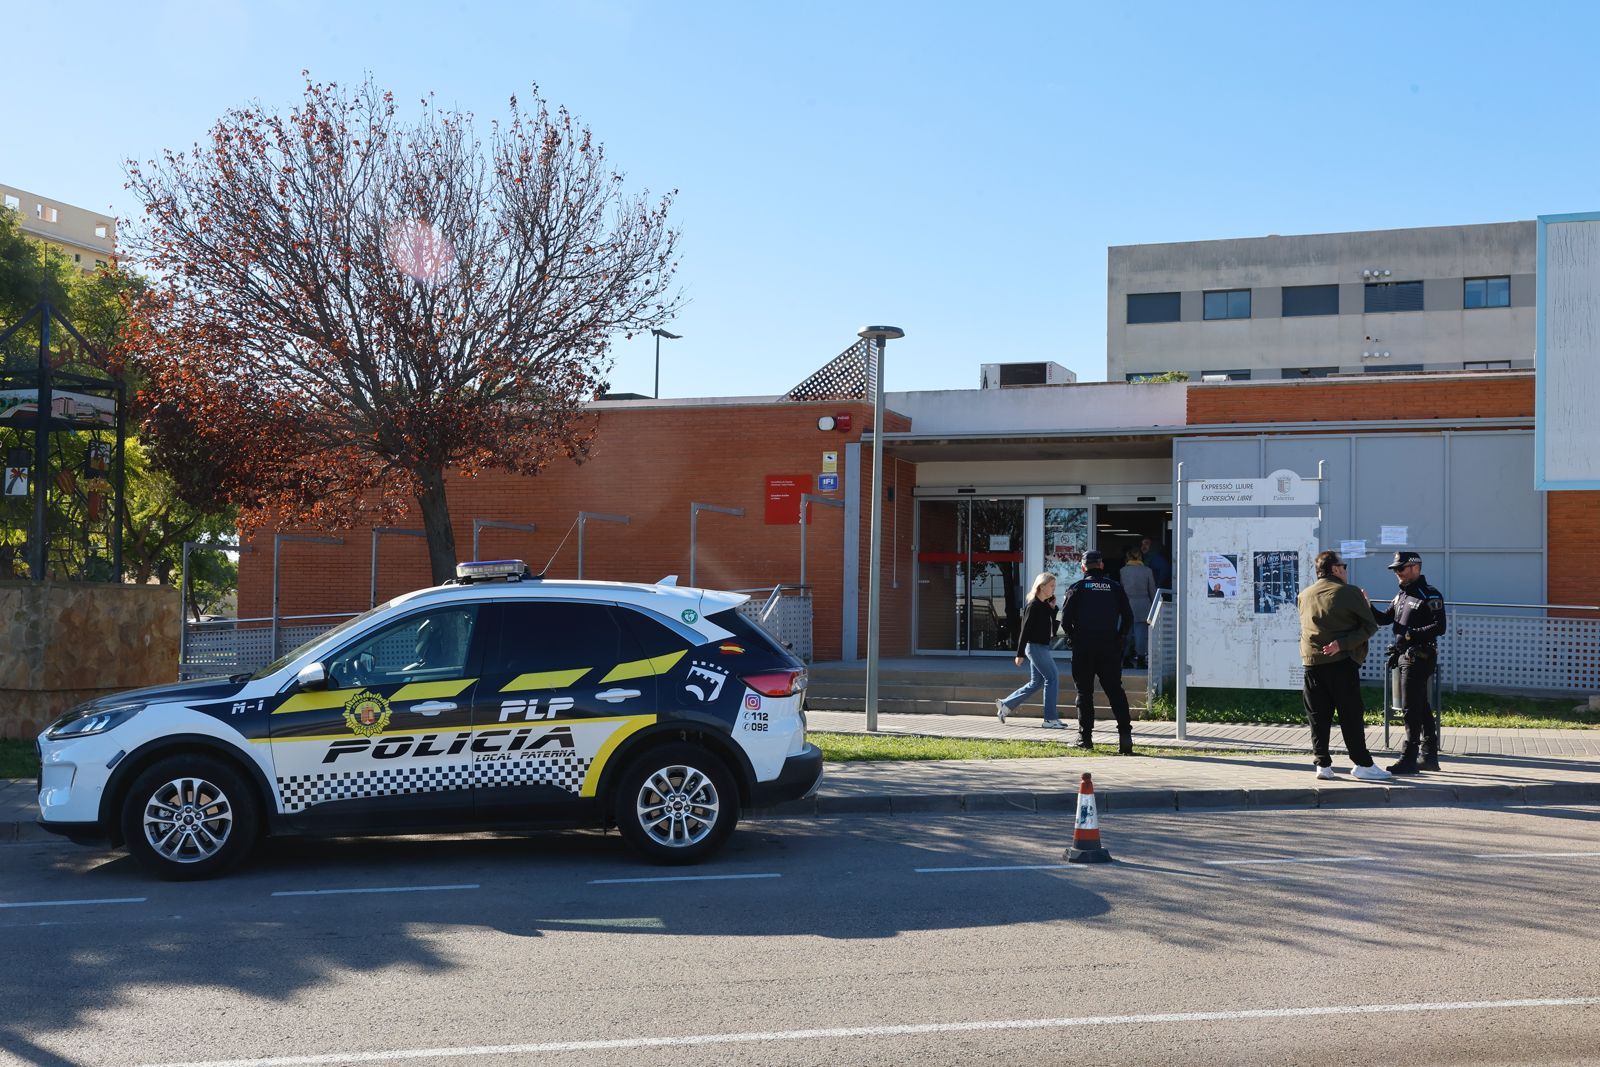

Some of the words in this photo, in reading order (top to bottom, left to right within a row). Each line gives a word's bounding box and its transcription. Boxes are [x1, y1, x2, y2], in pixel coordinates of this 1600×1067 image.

[1201, 482, 1233, 490] EXPRESSIÓ
[1201, 494, 1235, 502] EXPRESIÓN
[498, 697, 574, 722] PLP
[751, 712, 769, 721] 112
[751, 723, 769, 732] 092
[475, 752, 513, 763] LOCAL
[520, 749, 576, 761] PATERNA
